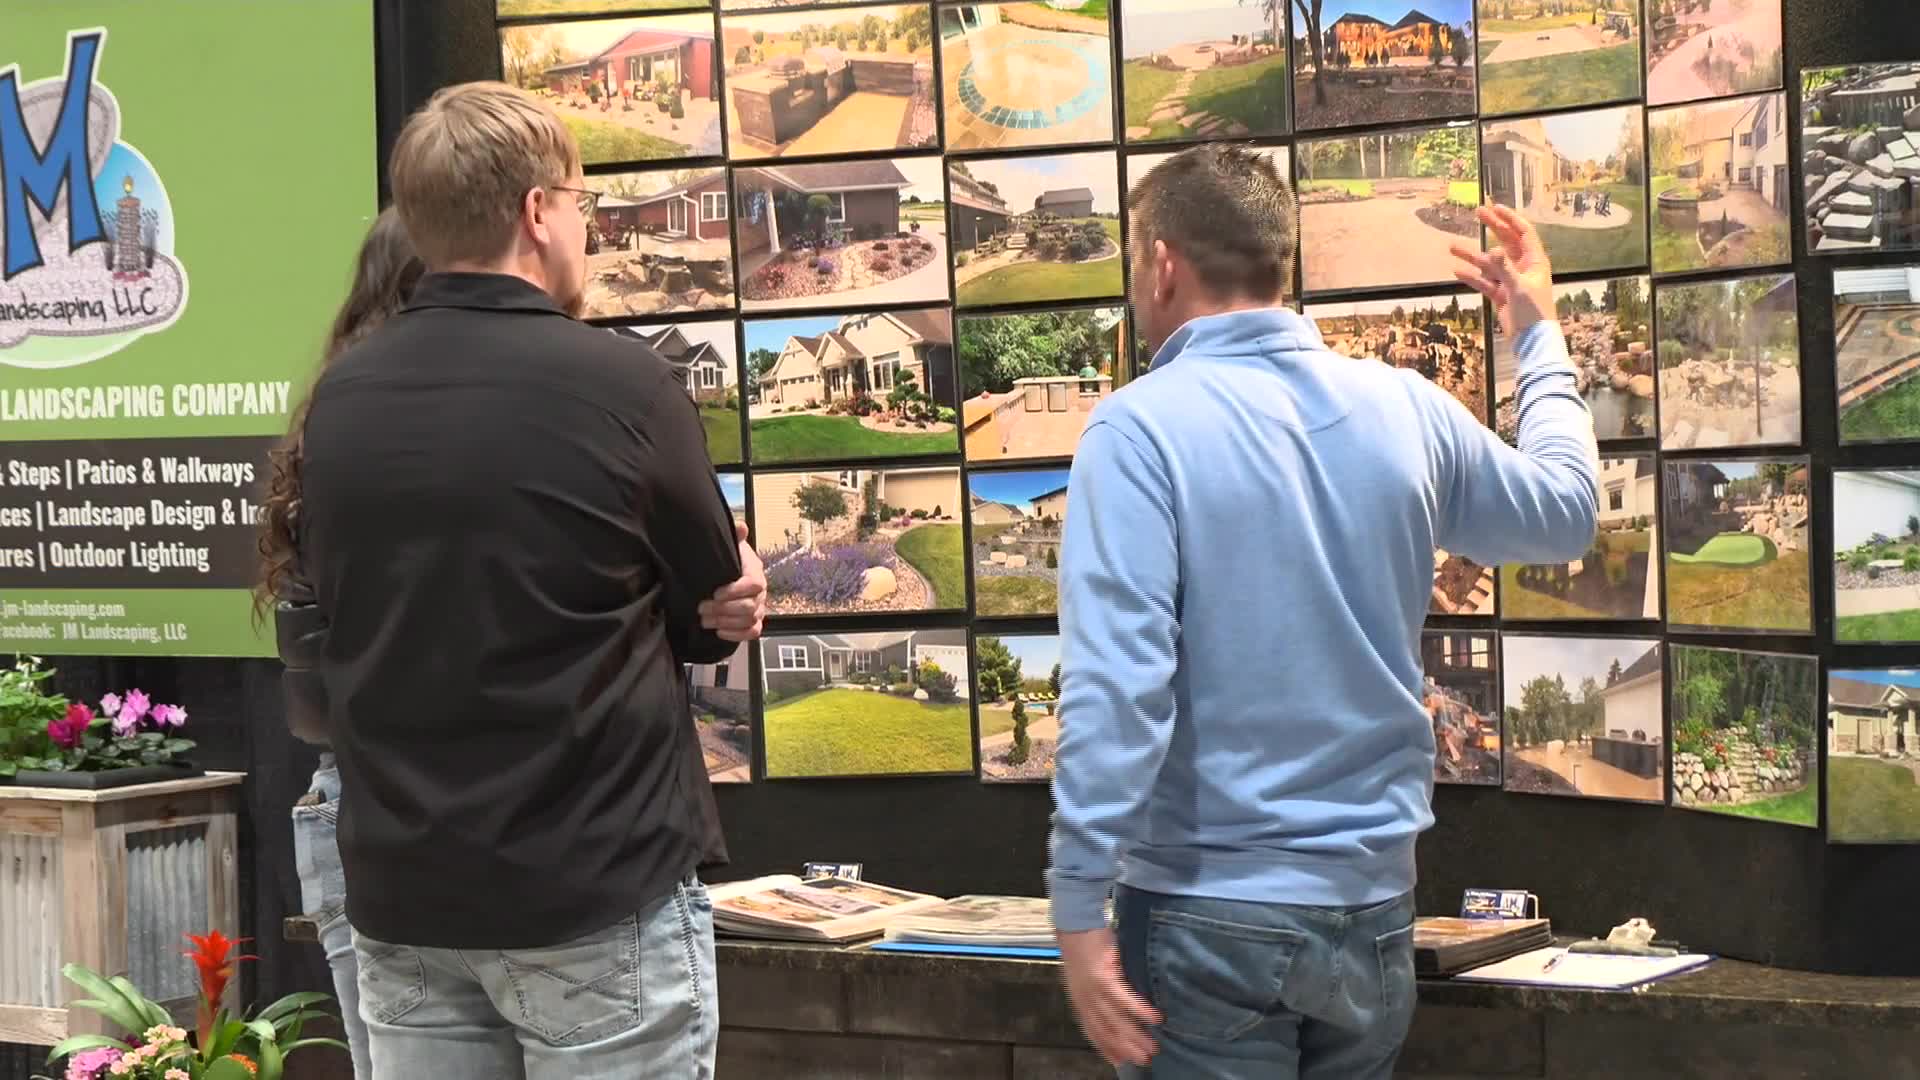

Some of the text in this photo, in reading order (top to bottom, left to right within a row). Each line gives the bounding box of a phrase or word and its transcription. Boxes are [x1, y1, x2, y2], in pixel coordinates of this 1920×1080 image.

[112, 287, 158, 316] LLC
[2, 381, 291, 421] LANDSCAPING COMPANY
[9, 459, 60, 490] Steps
[77, 458, 137, 485] Patios
[142, 458, 156, 484] &
[160, 456, 255, 488] Walkways
[0, 507, 31, 528] ces
[47, 500, 146, 531] Landscape
[151, 499, 216, 531] Design
[222, 498, 236, 525] &
[50, 541, 125, 568] Outdoor
[131, 541, 210, 573] Lighting
[164, 623, 188, 641] LLC
